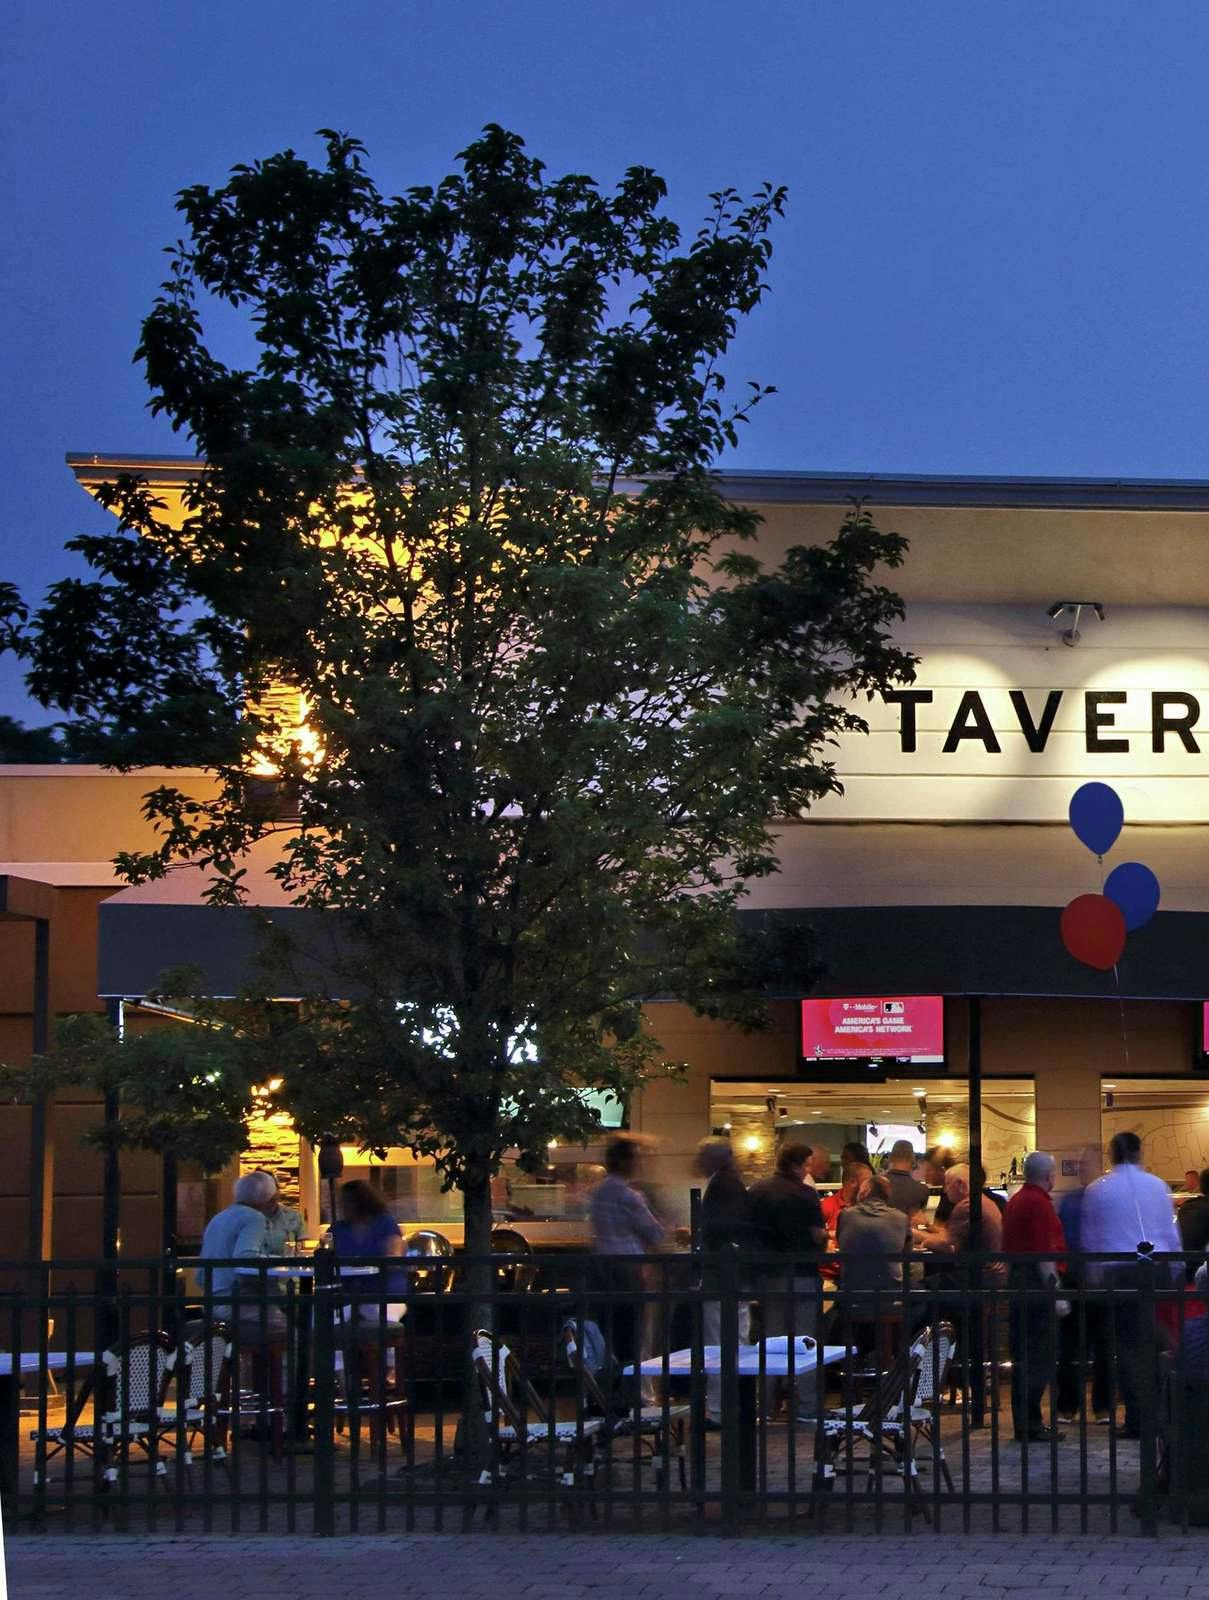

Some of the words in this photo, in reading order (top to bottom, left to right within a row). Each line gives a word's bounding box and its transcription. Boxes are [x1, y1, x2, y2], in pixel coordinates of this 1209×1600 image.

[842, 1016, 881, 1025] AMERICA'S
[882, 1016, 904, 1025] GAME
[834, 1025, 873, 1034] AMERICA'S
[875, 1025, 912, 1033] NETWORK
